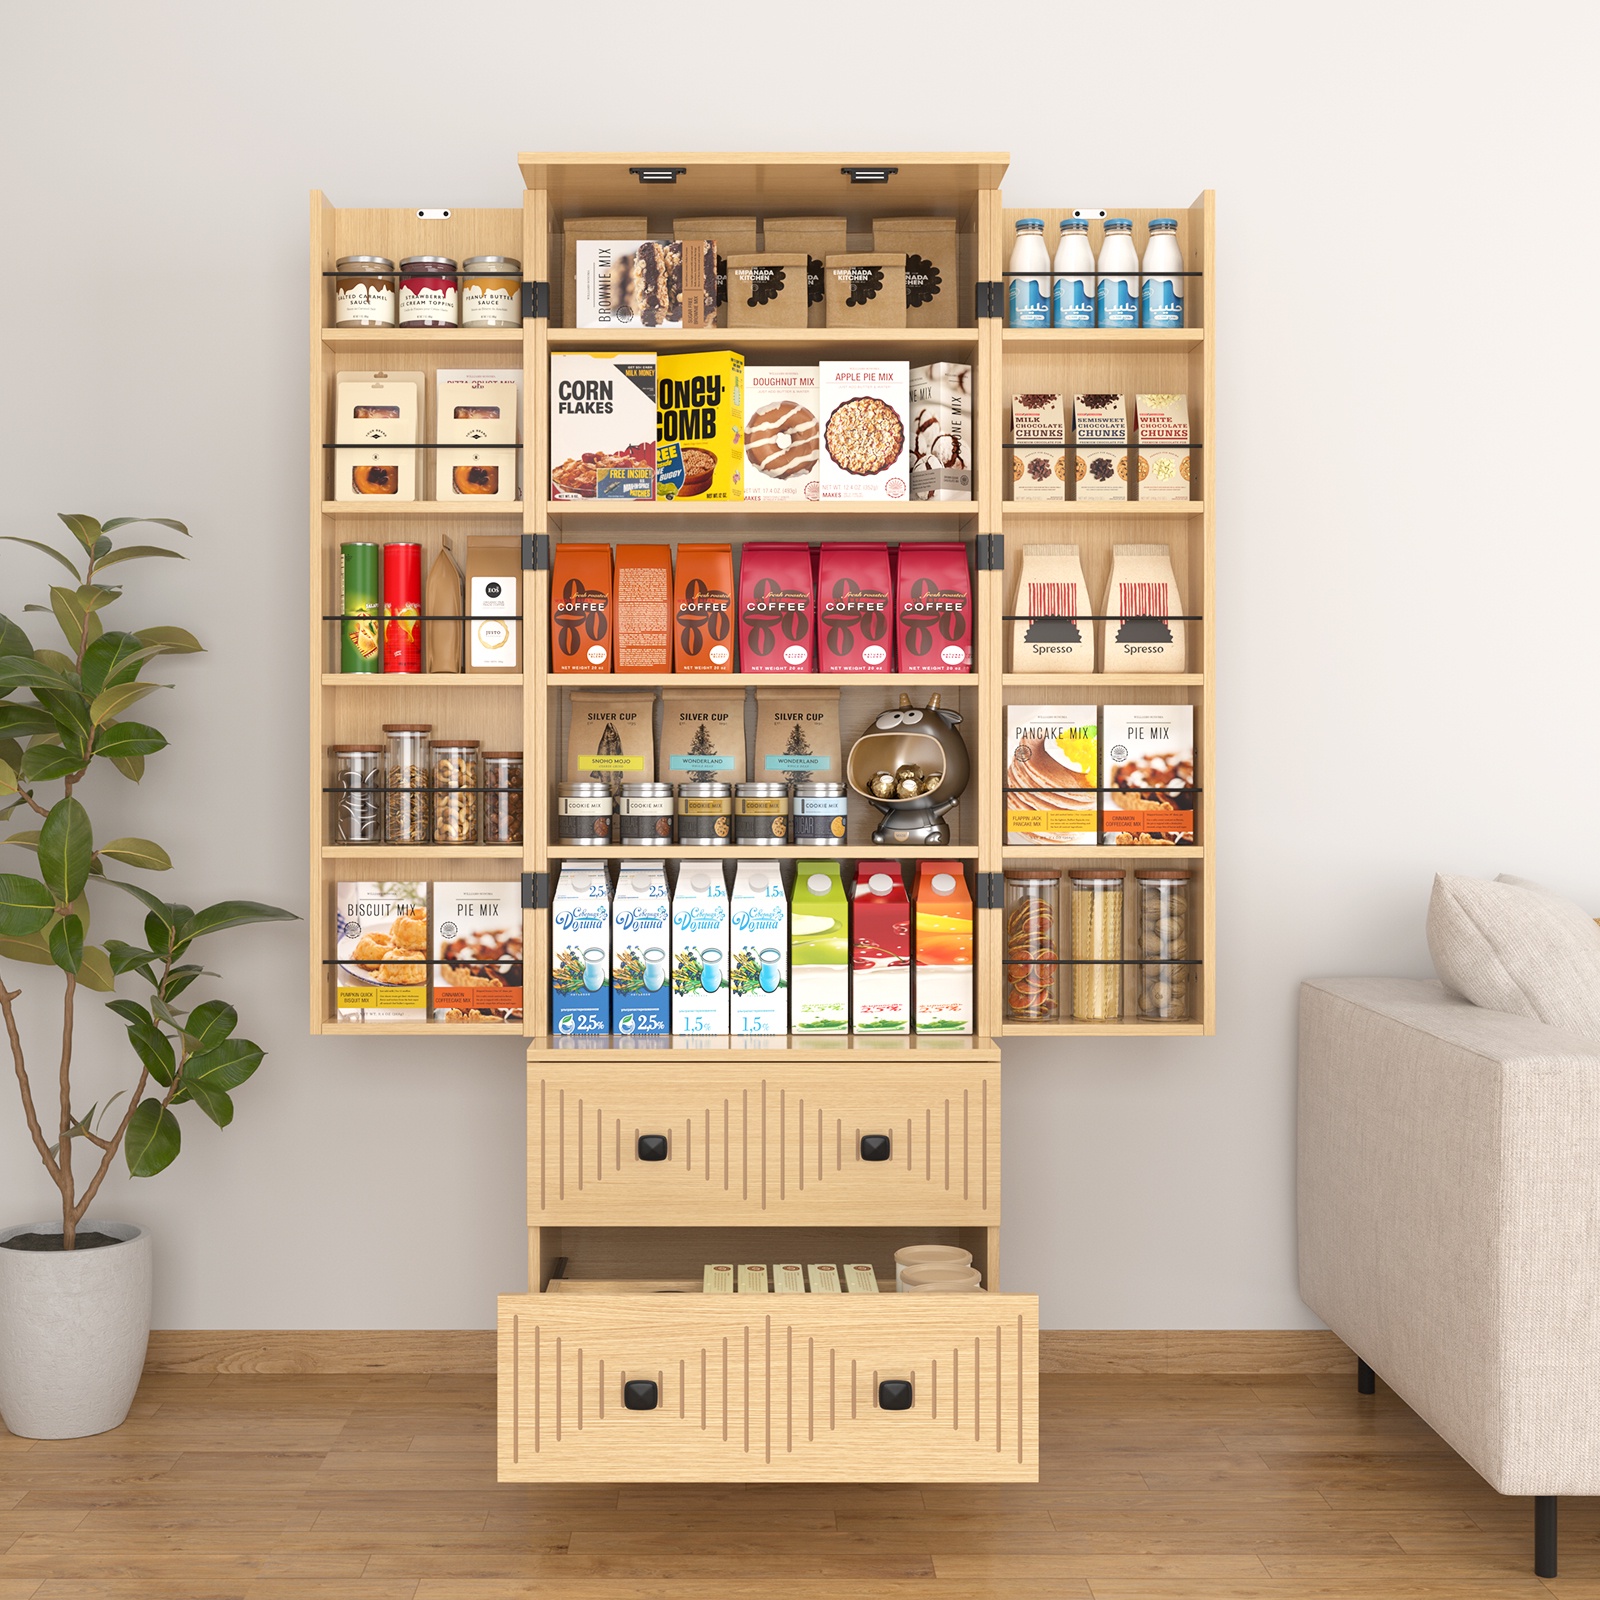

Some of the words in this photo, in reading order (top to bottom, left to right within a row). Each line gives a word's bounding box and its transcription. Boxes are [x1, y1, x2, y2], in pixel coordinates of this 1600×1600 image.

[599, 248, 611, 267] MIX
[599, 273, 611, 322] BROWNIE
[1016, 303, 1049, 314] حليب
[1060, 303, 1093, 314] حليب
[1104, 303, 1137, 314] حليب
[1150, 303, 1182, 314] حليب
[753, 378, 797, 386] DOUGHNUT
[800, 378, 814, 386] MIX
[836, 373, 860, 381] APPLE
[864, 373, 875, 381] PIE
[878, 373, 893, 381] MIX
[559, 381, 613, 400] CORN
[920, 387, 932, 400] MIX
[559, 402, 613, 414] FLAKES
[952, 397, 961, 415] MIX
[610, 470, 625, 478] FREE
[558, 603, 604, 611] COFFEE
[680, 603, 727, 611] COFFEE
[747, 603, 805, 611] COFFEE
[826, 603, 884, 611] COFFEE
[904, 603, 962, 611] COFFEE
[1032, 644, 1072, 655] Spresso
[1124, 644, 1164, 655] Spresso
[1016, 727, 1063, 740] PANCAKE
[1070, 727, 1089, 740] MIX
[1128, 727, 1144, 740] PIE
[1150, 727, 1170, 740] MIX
[348, 903, 390, 917] BISCUIT
[397, 903, 416, 917] MIX
[457, 903, 473, 917] PIE
[480, 903, 499, 917] MIX
[556, 911, 602, 932] Долина
[616, 911, 662, 932] Долина
[674, 911, 720, 932] Долина
[732, 911, 778, 932] Долина
[578, 1014, 604, 1031] 2,5%
[638, 1014, 664, 1031] 2,5%
[684, 1017, 711, 1033] 1,5%
[742, 1017, 769, 1033] 1,5%
